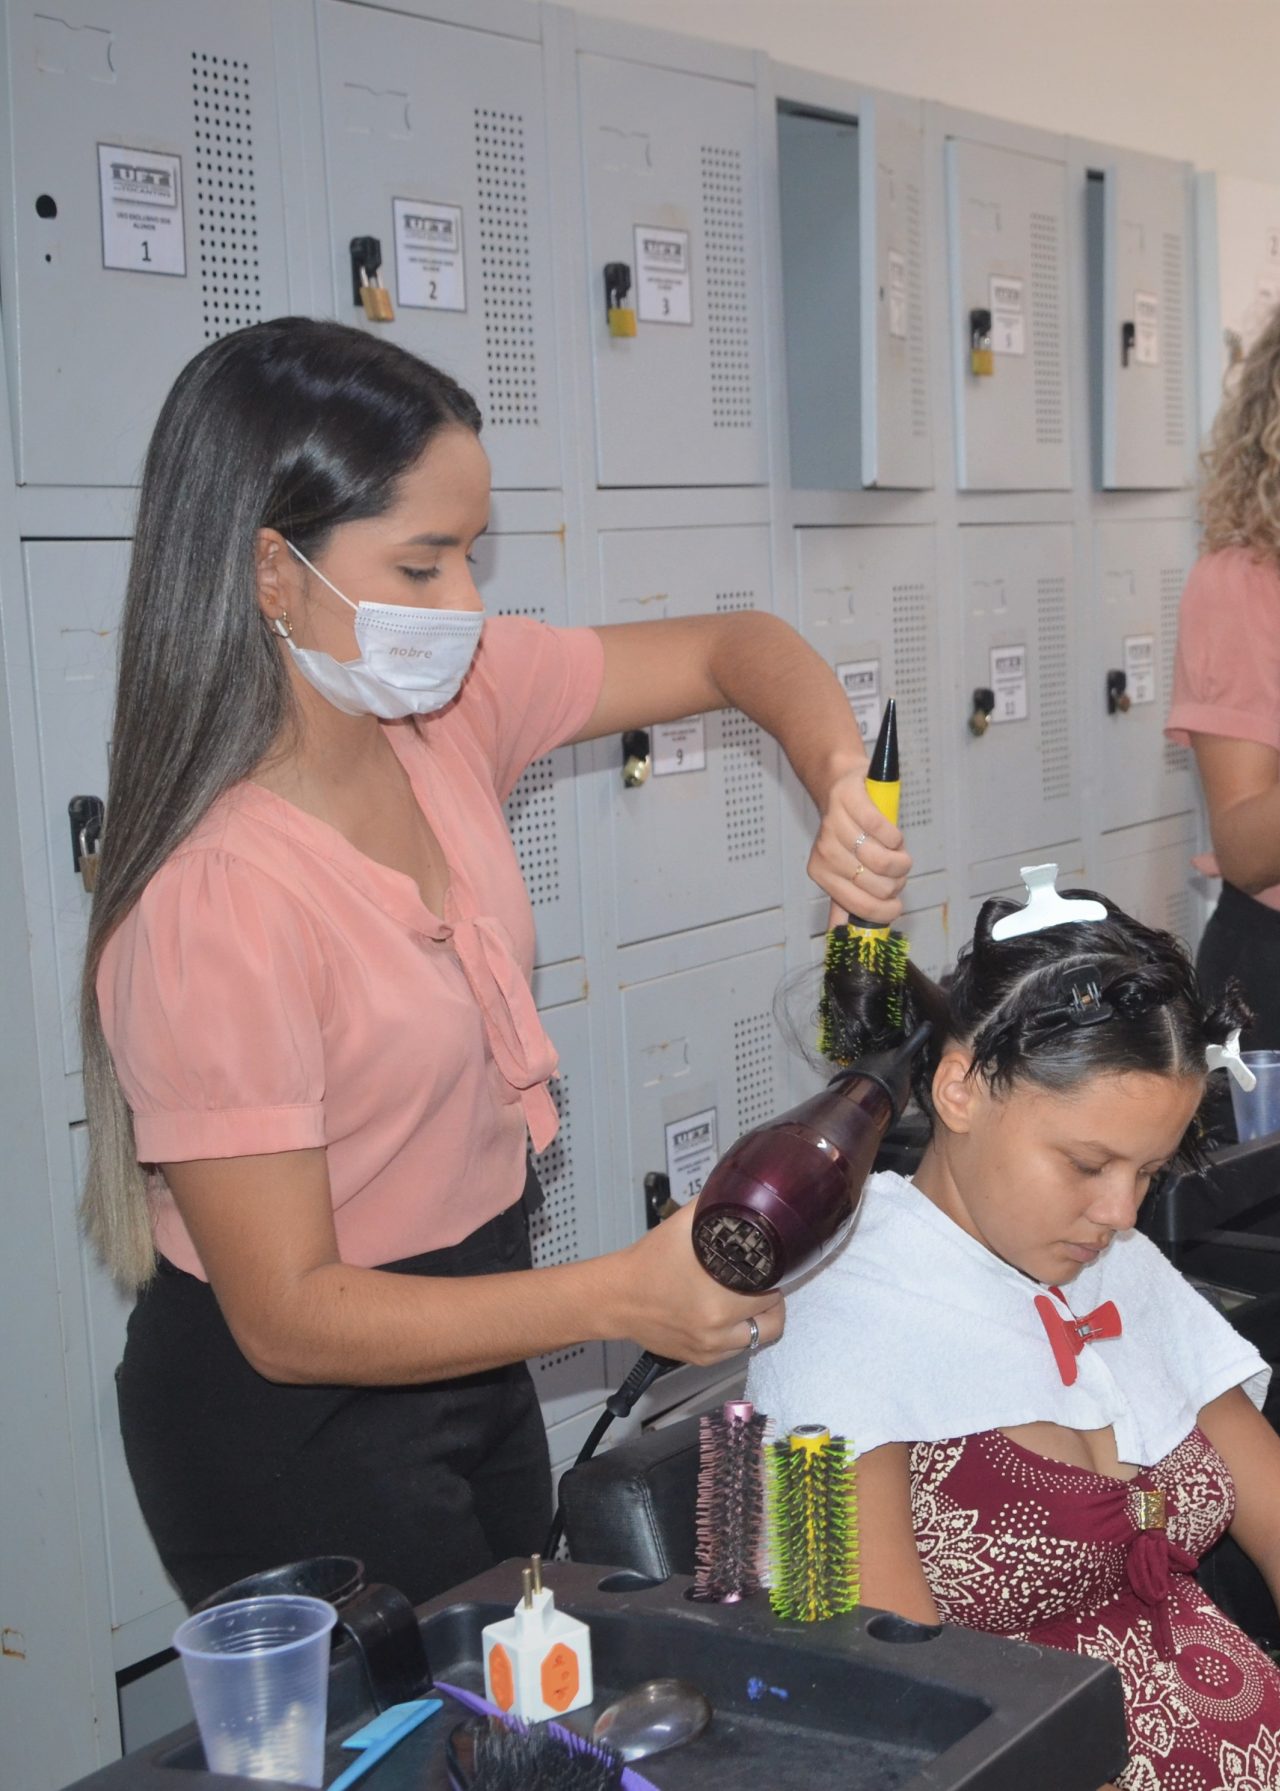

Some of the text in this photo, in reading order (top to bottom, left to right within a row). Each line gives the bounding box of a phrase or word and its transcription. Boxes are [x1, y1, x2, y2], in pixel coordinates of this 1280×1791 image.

[142, 240, 151, 262] 1
[429, 281, 437, 300] 2
[662, 297, 670, 315] 3
[389, 647, 432, 659] nobre
[675, 748, 683, 766] 9
[688, 1178, 702, 1197] 15
